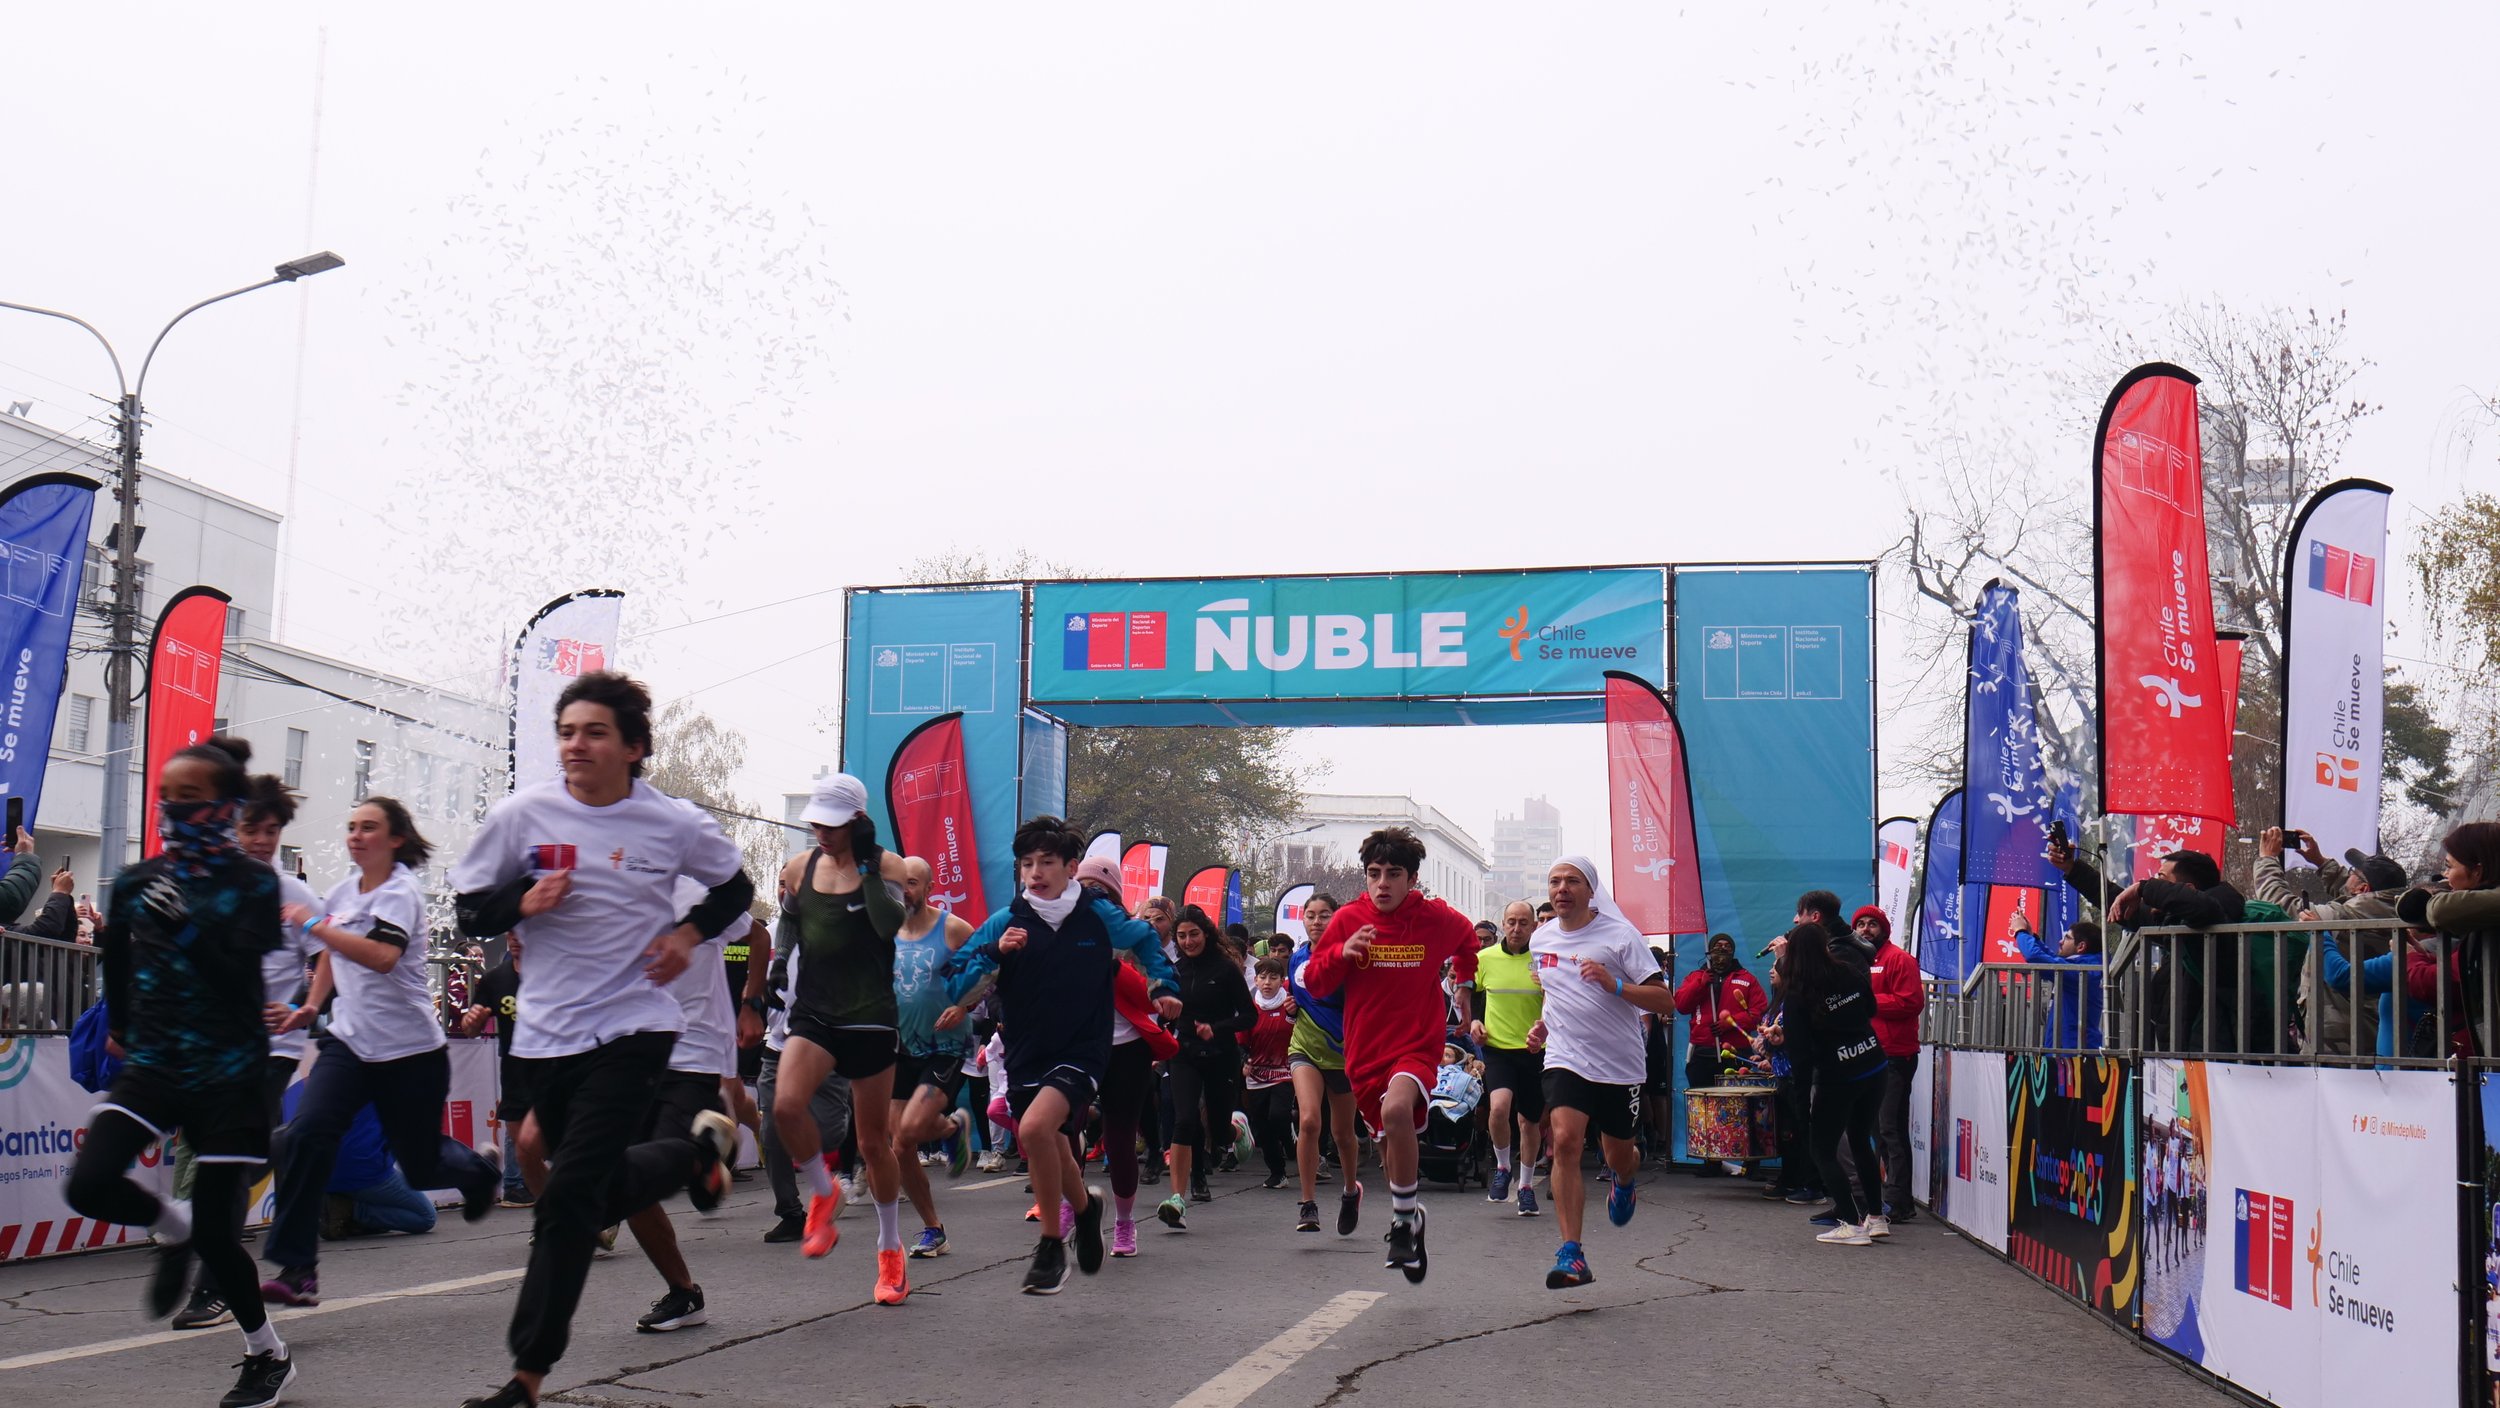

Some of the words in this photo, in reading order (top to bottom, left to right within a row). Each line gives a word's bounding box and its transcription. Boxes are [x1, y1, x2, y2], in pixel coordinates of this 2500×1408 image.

[2173, 549, 2190, 635] mueve
[1195, 598, 1467, 671] ÑUBLE
[1538, 625, 1586, 641] Chile
[2160, 606, 2178, 667] Chile
[1538, 644, 1565, 660] Se
[1568, 645, 1637, 660] mueve
[2180, 641, 2196, 674] Se
[8, 648, 32, 727] mueve
[2351, 653, 2361, 721] mueve
[2333, 700, 2346, 748] Chile
[2347, 726, 2360, 751] Se
[0, 732, 17, 762] Se
[2000, 746, 2012, 788] Chile
[944, 816, 960, 862] mueve
[937, 852, 948, 886] Chile
[952, 865, 962, 883] Se
[1945, 892, 1954, 918] Chile
[1828, 1002, 1838, 1012] Se
[1838, 992, 1860, 1006] mueve
[1837, 1036, 1877, 1061] ÑUBLE
[0, 1121, 90, 1159] antiag
[1980, 1146, 1989, 1164] Chile
[0, 1171, 20, 1184] egos
[22, 1167, 52, 1179] PanAm
[1980, 1165, 1984, 1181] Se
[1985, 1170, 1997, 1186] mueve
[2036, 1143, 2069, 1195] Santiago
[2070, 1147, 2104, 1226] 2023
[2329, 1251, 2360, 1285] Chile
[2329, 1285, 2344, 1316] Se
[2348, 1298, 2394, 1333] mueve
